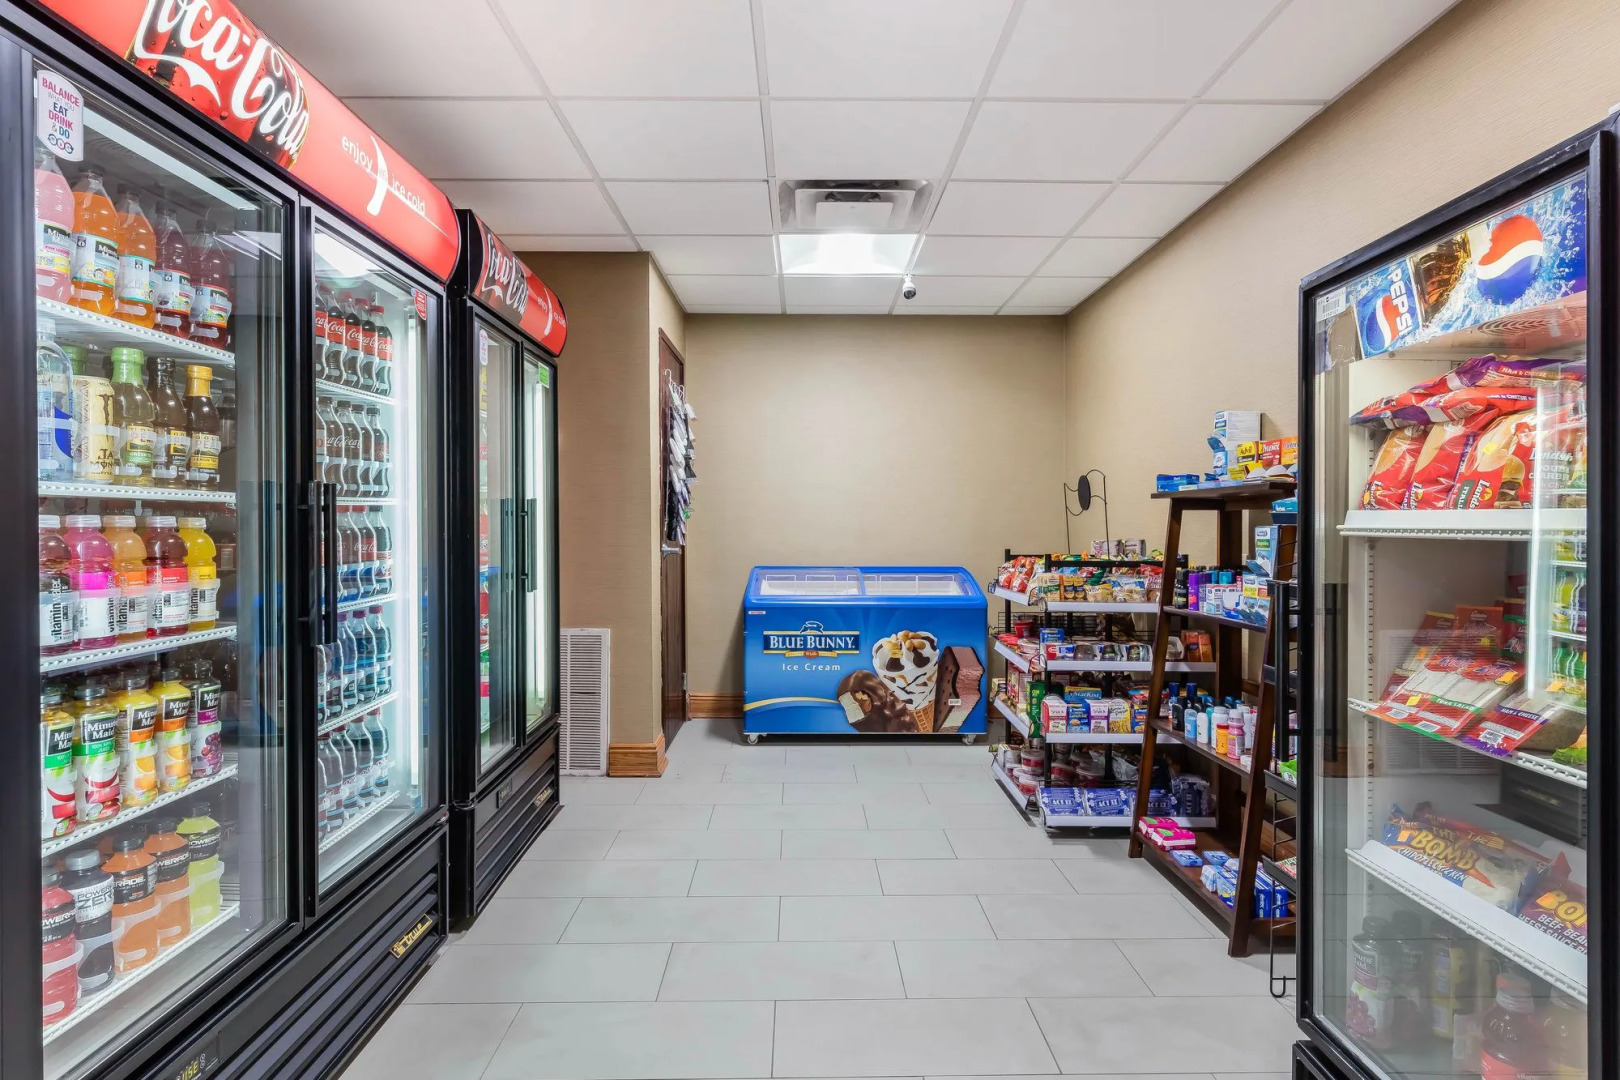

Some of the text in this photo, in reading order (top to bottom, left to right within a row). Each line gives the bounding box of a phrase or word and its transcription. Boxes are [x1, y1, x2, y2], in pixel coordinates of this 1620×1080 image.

[42, 77, 80, 107] BALANCE
[53, 102, 68, 117] EAT
[48, 110, 74, 132] DRINK
[58, 126, 70, 139] DO
[341, 136, 373, 172] enjoy
[391, 173, 426, 217] ice cold
[481, 232, 529, 316] Coca-Cola
[1388, 268, 1413, 335] PEPSI
[1502, 366, 1518, 375] HAM
[1240, 446, 1253, 456] Advil
[769, 635, 804, 649] BLUE
[782, 663, 841, 671] Ice Cream
[1518, 711, 1540, 720] CHEESE
[1410, 829, 1479, 871] BOMB
